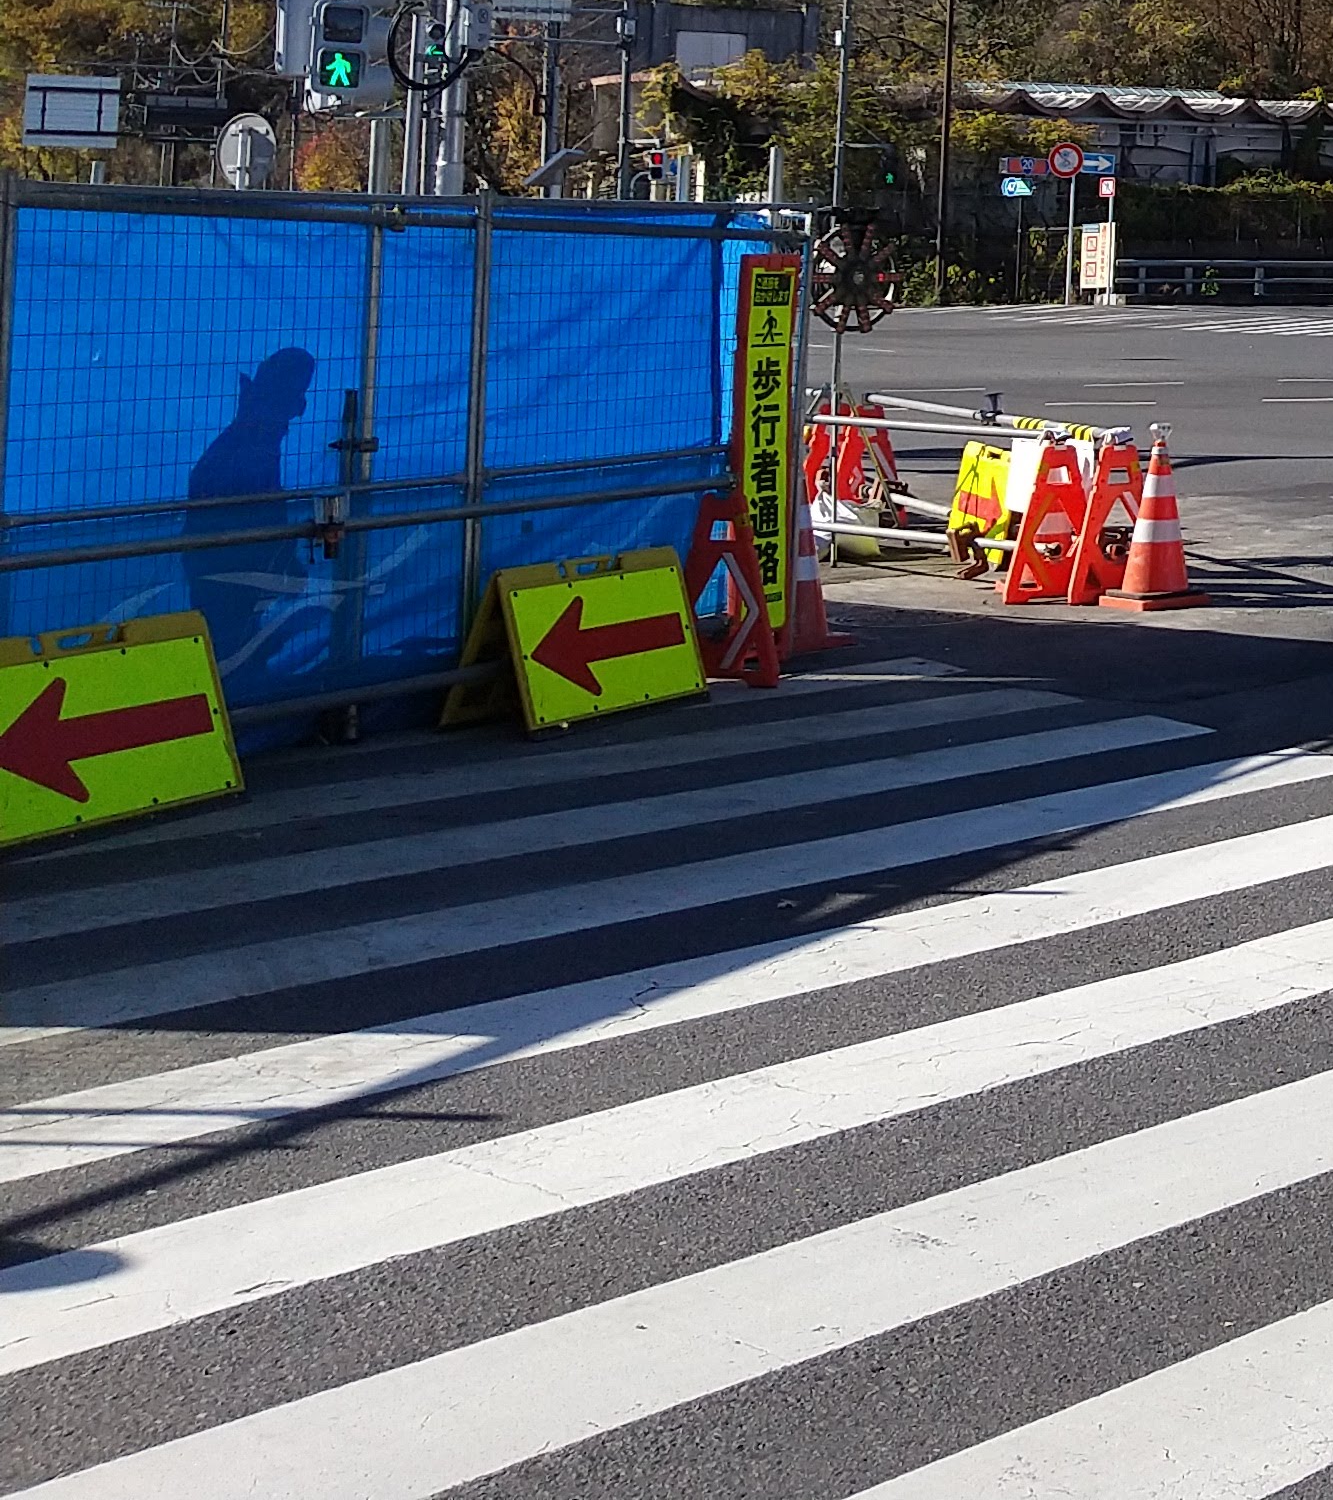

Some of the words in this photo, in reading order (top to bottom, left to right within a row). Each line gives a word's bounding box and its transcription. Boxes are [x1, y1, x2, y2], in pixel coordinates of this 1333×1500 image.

[1022, 159, 1034, 170] 20
[750, 357, 782, 586] 歩行者通路
